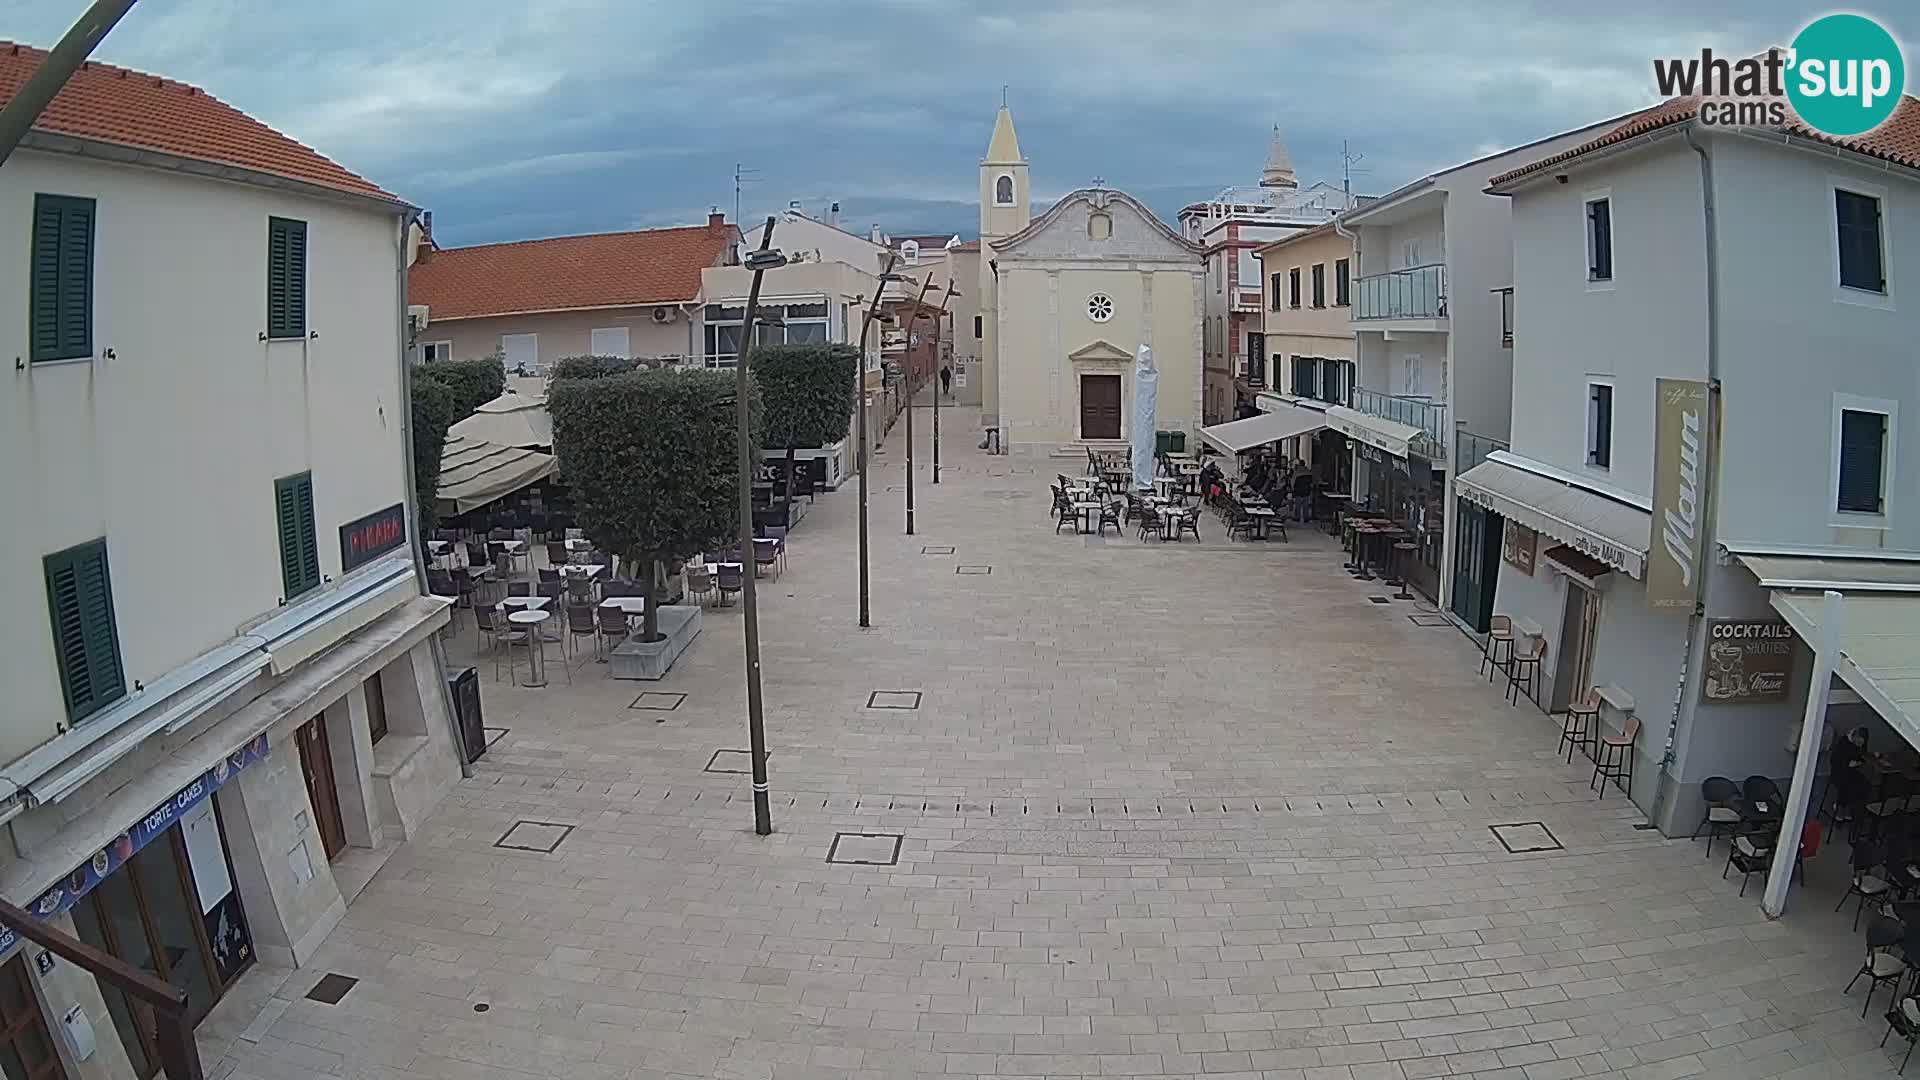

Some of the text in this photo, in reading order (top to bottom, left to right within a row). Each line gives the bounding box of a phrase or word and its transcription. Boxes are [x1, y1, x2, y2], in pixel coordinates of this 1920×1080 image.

[1601, 543, 1625, 568] MAUN
[1712, 624, 1792, 638] COCKTAILS
[144, 803, 173, 833] TORTE
[177, 780, 203, 809] CAKES
